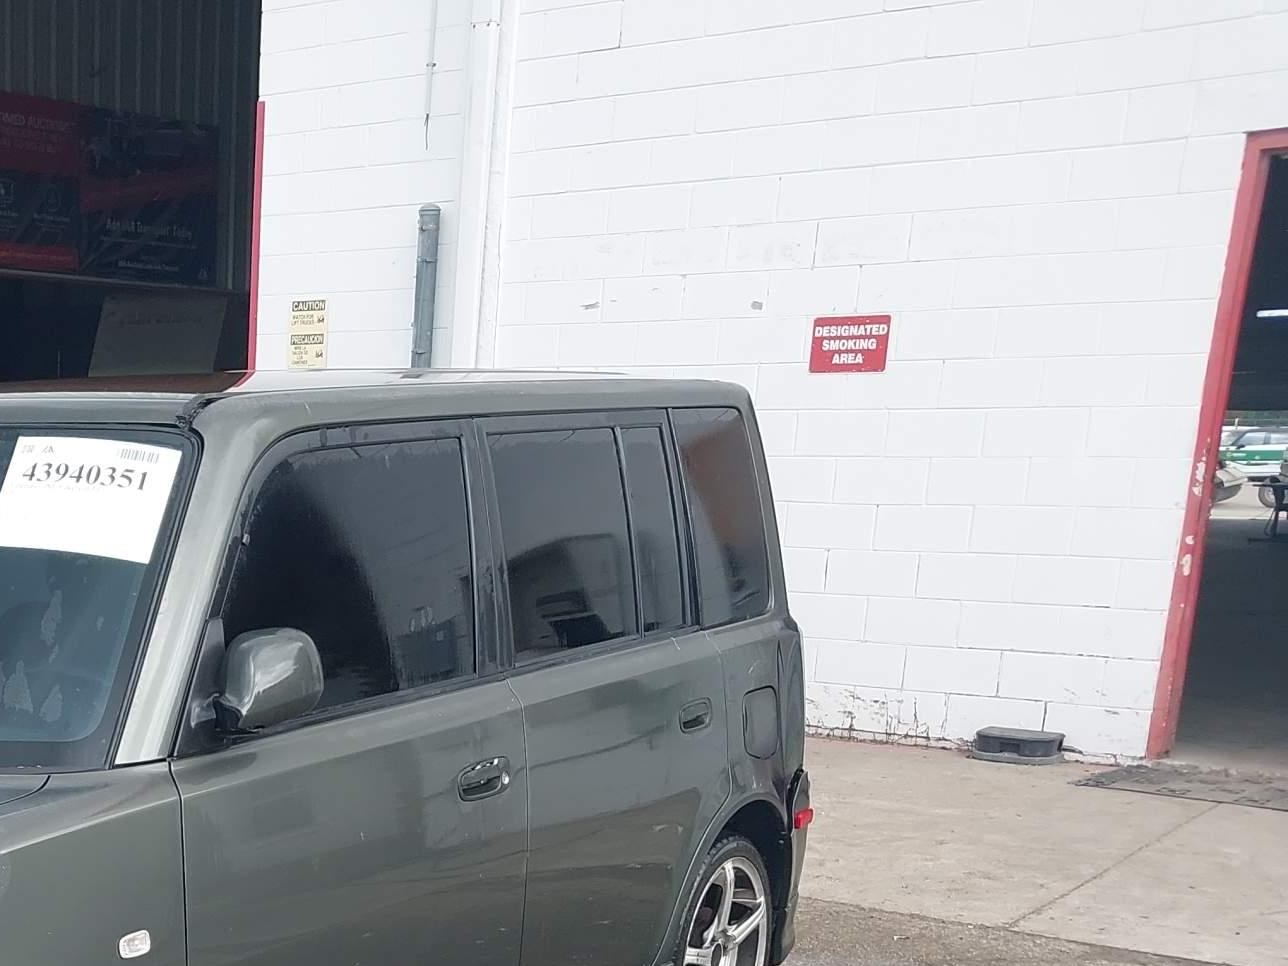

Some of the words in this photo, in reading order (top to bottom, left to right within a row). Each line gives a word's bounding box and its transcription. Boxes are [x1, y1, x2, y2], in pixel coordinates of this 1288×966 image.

[293, 301, 325, 311] CAUTION
[814, 324, 888, 337] DESIGNATED
[822, 338, 877, 351] SMOKING
[831, 352, 864, 365] AREA
[21, 461, 149, 491] 43940351
